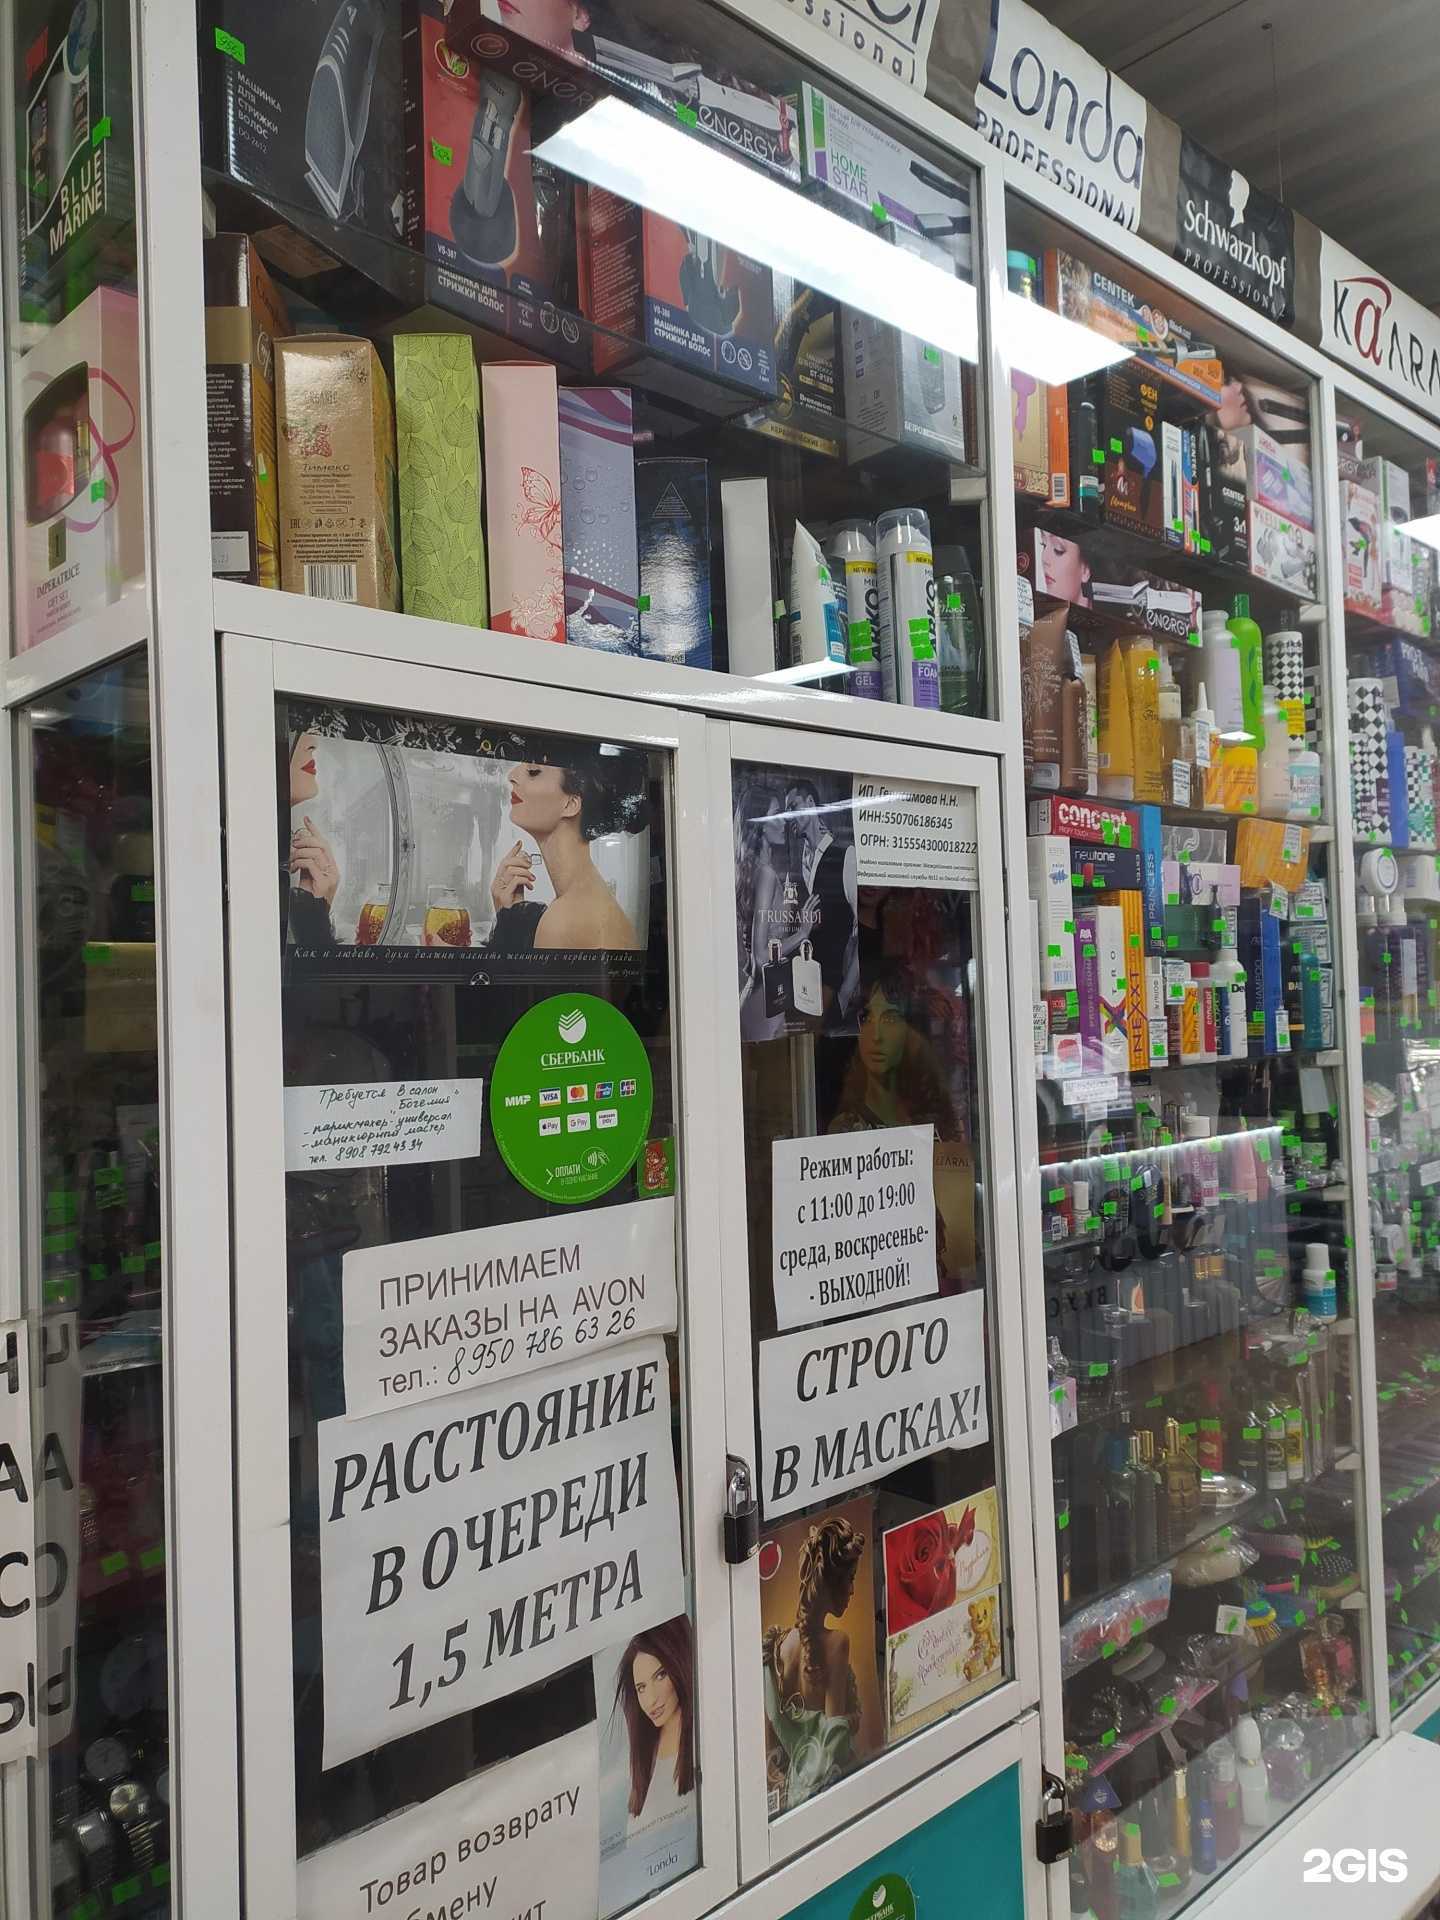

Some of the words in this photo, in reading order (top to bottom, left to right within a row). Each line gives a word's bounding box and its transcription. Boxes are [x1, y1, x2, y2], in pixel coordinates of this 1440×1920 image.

[787, 0, 917, 85] ssional
[238, 71, 282, 112] МАШИНКА
[238, 84, 256, 104] ДЛЯ
[979, 0, 1145, 187] Londa
[238, 98, 280, 135] СТРИЖКИ
[239, 109, 269, 139] ВОЛОС
[61, 149, 102, 217] BLUE
[831, 151, 868, 180] HOME
[833, 167, 869, 200] STAR
[50, 179, 103, 255] MARINE
[1184, 199, 1287, 297] Schwarzkopf
[438, 275, 476, 301] СТРИЖКИ
[478, 294, 505, 313] ВОЛОС
[481, 281, 498, 298] ДЛЯ
[1093, 271, 1136, 308] CENTEK
[654, 318, 690, 340] МАШИНКА
[691, 331, 706, 345] ДЛЯ
[654, 327, 688, 348] СТРИЖКИ
[688, 341, 712, 358] ВОЛОС
[1140, 383, 1158, 399] ФЕН
[1190, 434, 1198, 479] CENTEK
[37, 562, 81, 599] IMPERATRICE
[855, 675, 875, 686] GEL
[860, 833, 890, 848] ОГРН:
[1147, 853, 1156, 919] PRINCESS
[758, 909, 822, 924] TRUSSARDI
[294, 946, 317, 960] Как
[1127, 968, 1148, 1053] NEXXT
[541, 1049, 606, 1067] СБЕРБАНК
[319, 1088, 386, 1109] Требуется
[409, 1085, 439, 1097] салон
[505, 1094, 531, 1107] МИР
[543, 1092, 559, 1101] VISA
[311, 1129, 399, 1148] маникюрный
[404, 1122, 445, 1137] мастер
[548, 1121, 559, 1132] Pay
[577, 1118, 588, 1128] Pay
[336, 1146, 365, 1162] 8908
[371, 1144, 390, 1157] 792
[393, 1142, 406, 1153] 43
[409, 1139, 424, 1151] 34
[799, 1155, 853, 1181] Режим
[856, 1146, 914, 1180] работы:
[555, 1164, 580, 1178] ОПЛАТИ
[797, 1204, 806, 1224] с
[810, 1191, 853, 1223] 11:00
[857, 1193, 875, 1219] до
[877, 1181, 916, 1211] 19:00
[379, 1244, 581, 1310] ПРИНИМАЕМ
[779, 1242, 832, 1276] среда,
[818, 1256, 911, 1306] ВЫХОДНОЙ!
[379, 1303, 509, 1358] ЗАКАЗЫ
[519, 1294, 559, 1328] НА
[572, 1274, 647, 1315] AVON
[379, 1365, 440, 1397] тел.:
[526, 1326, 563, 1359] 786
[575, 1316, 599, 1344] 63
[606, 1306, 636, 1338] 26
[796, 1317, 950, 1402] СТРОГО
[328, 1360, 659, 1522] РАССТОЯНИЕ
[770, 1444, 801, 1502] В
[811, 1385, 981, 1487] МАСКАХ!
[366, 1545, 407, 1616] В
[421, 1451, 649, 1591] ОЧЕРЕДИ
[388, 1618, 470, 1711] 1,5
[482, 1548, 644, 1669] МЕТРА
[360, 1850, 446, 1914] Товар
[457, 1785, 581, 1863] возврату
[649, 1851, 678, 1876] Londa
